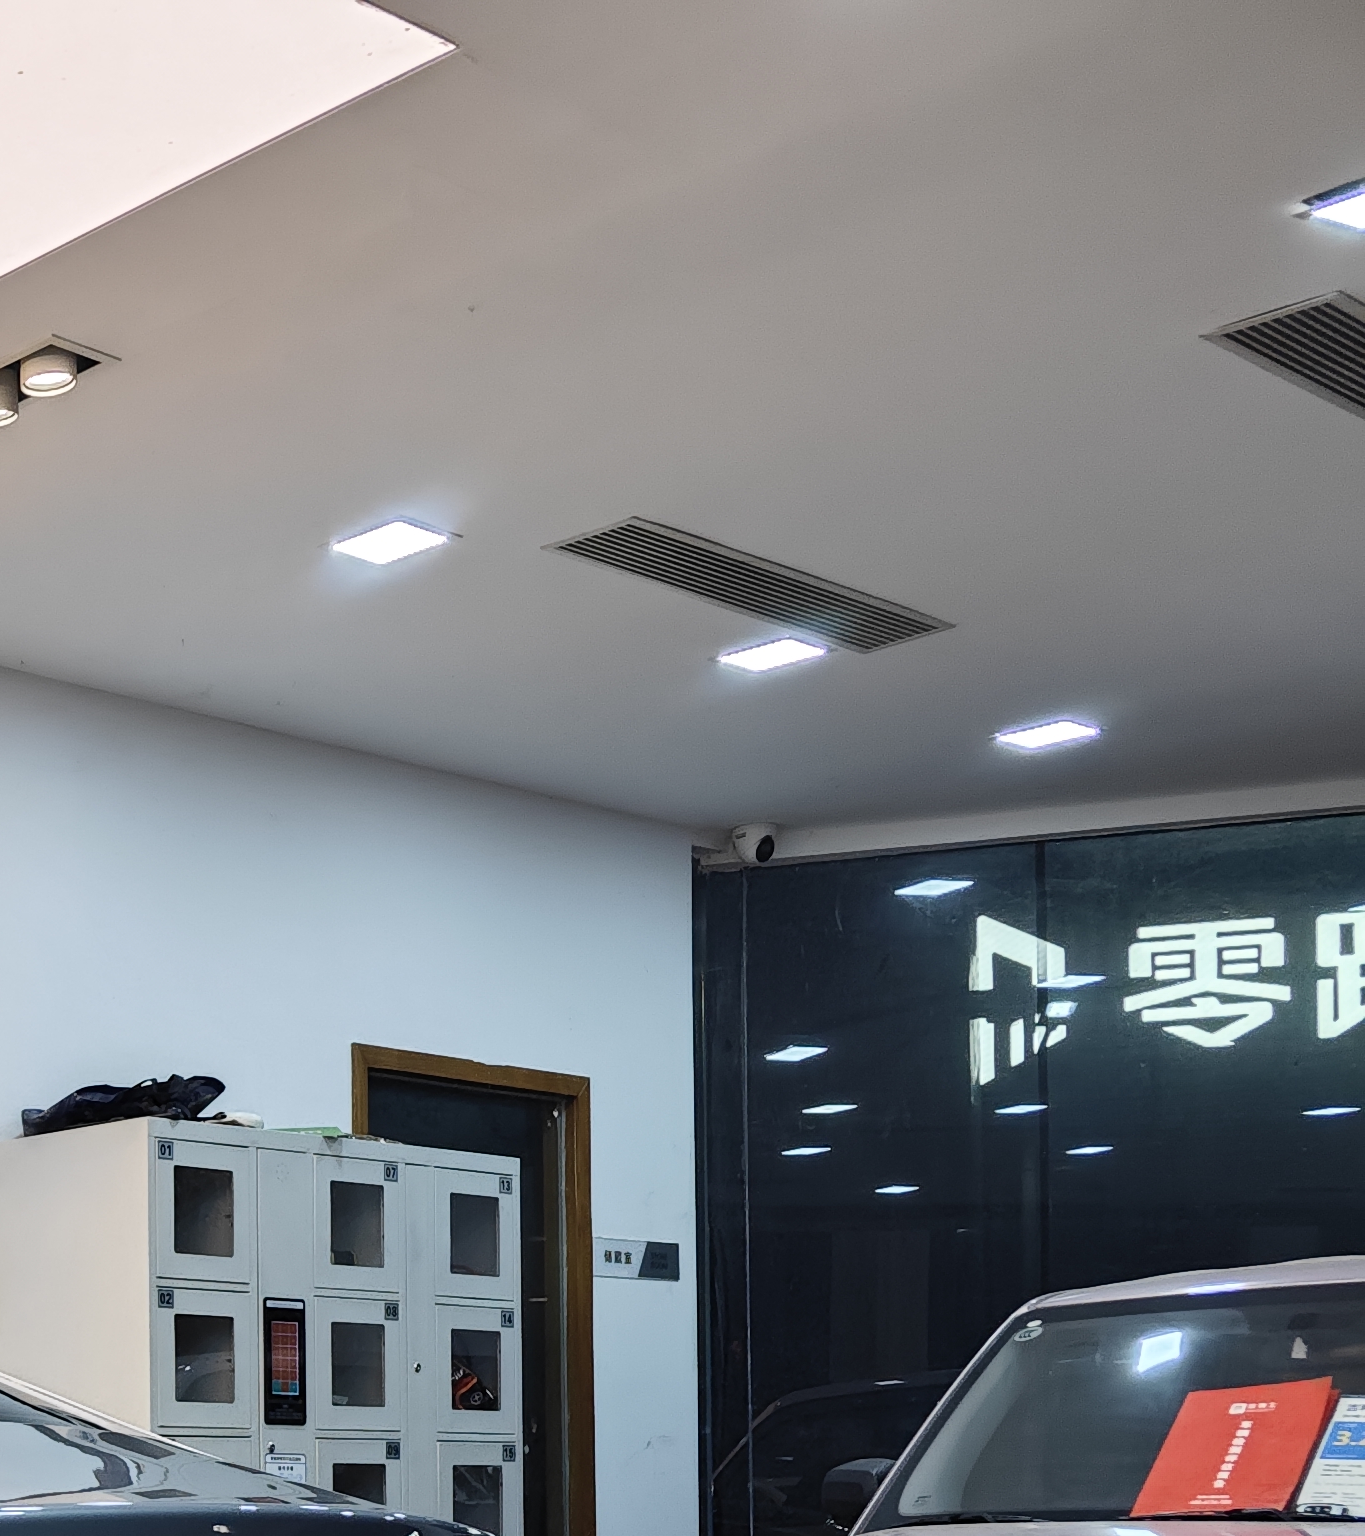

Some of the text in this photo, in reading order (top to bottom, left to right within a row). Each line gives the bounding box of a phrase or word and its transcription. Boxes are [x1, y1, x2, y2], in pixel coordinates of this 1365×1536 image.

[159, 1143, 172, 1157] 01
[385, 1166, 397, 1179] 07
[500, 1179, 511, 1192] 13
[159, 1292, 173, 1305] 02
[385, 1306, 397, 1318] 08
[502, 1312, 513, 1325] 14
[1332, 1430, 1365, 1446] 3.
[386, 1444, 399, 1457] 09
[502, 1447, 514, 1459] 15
